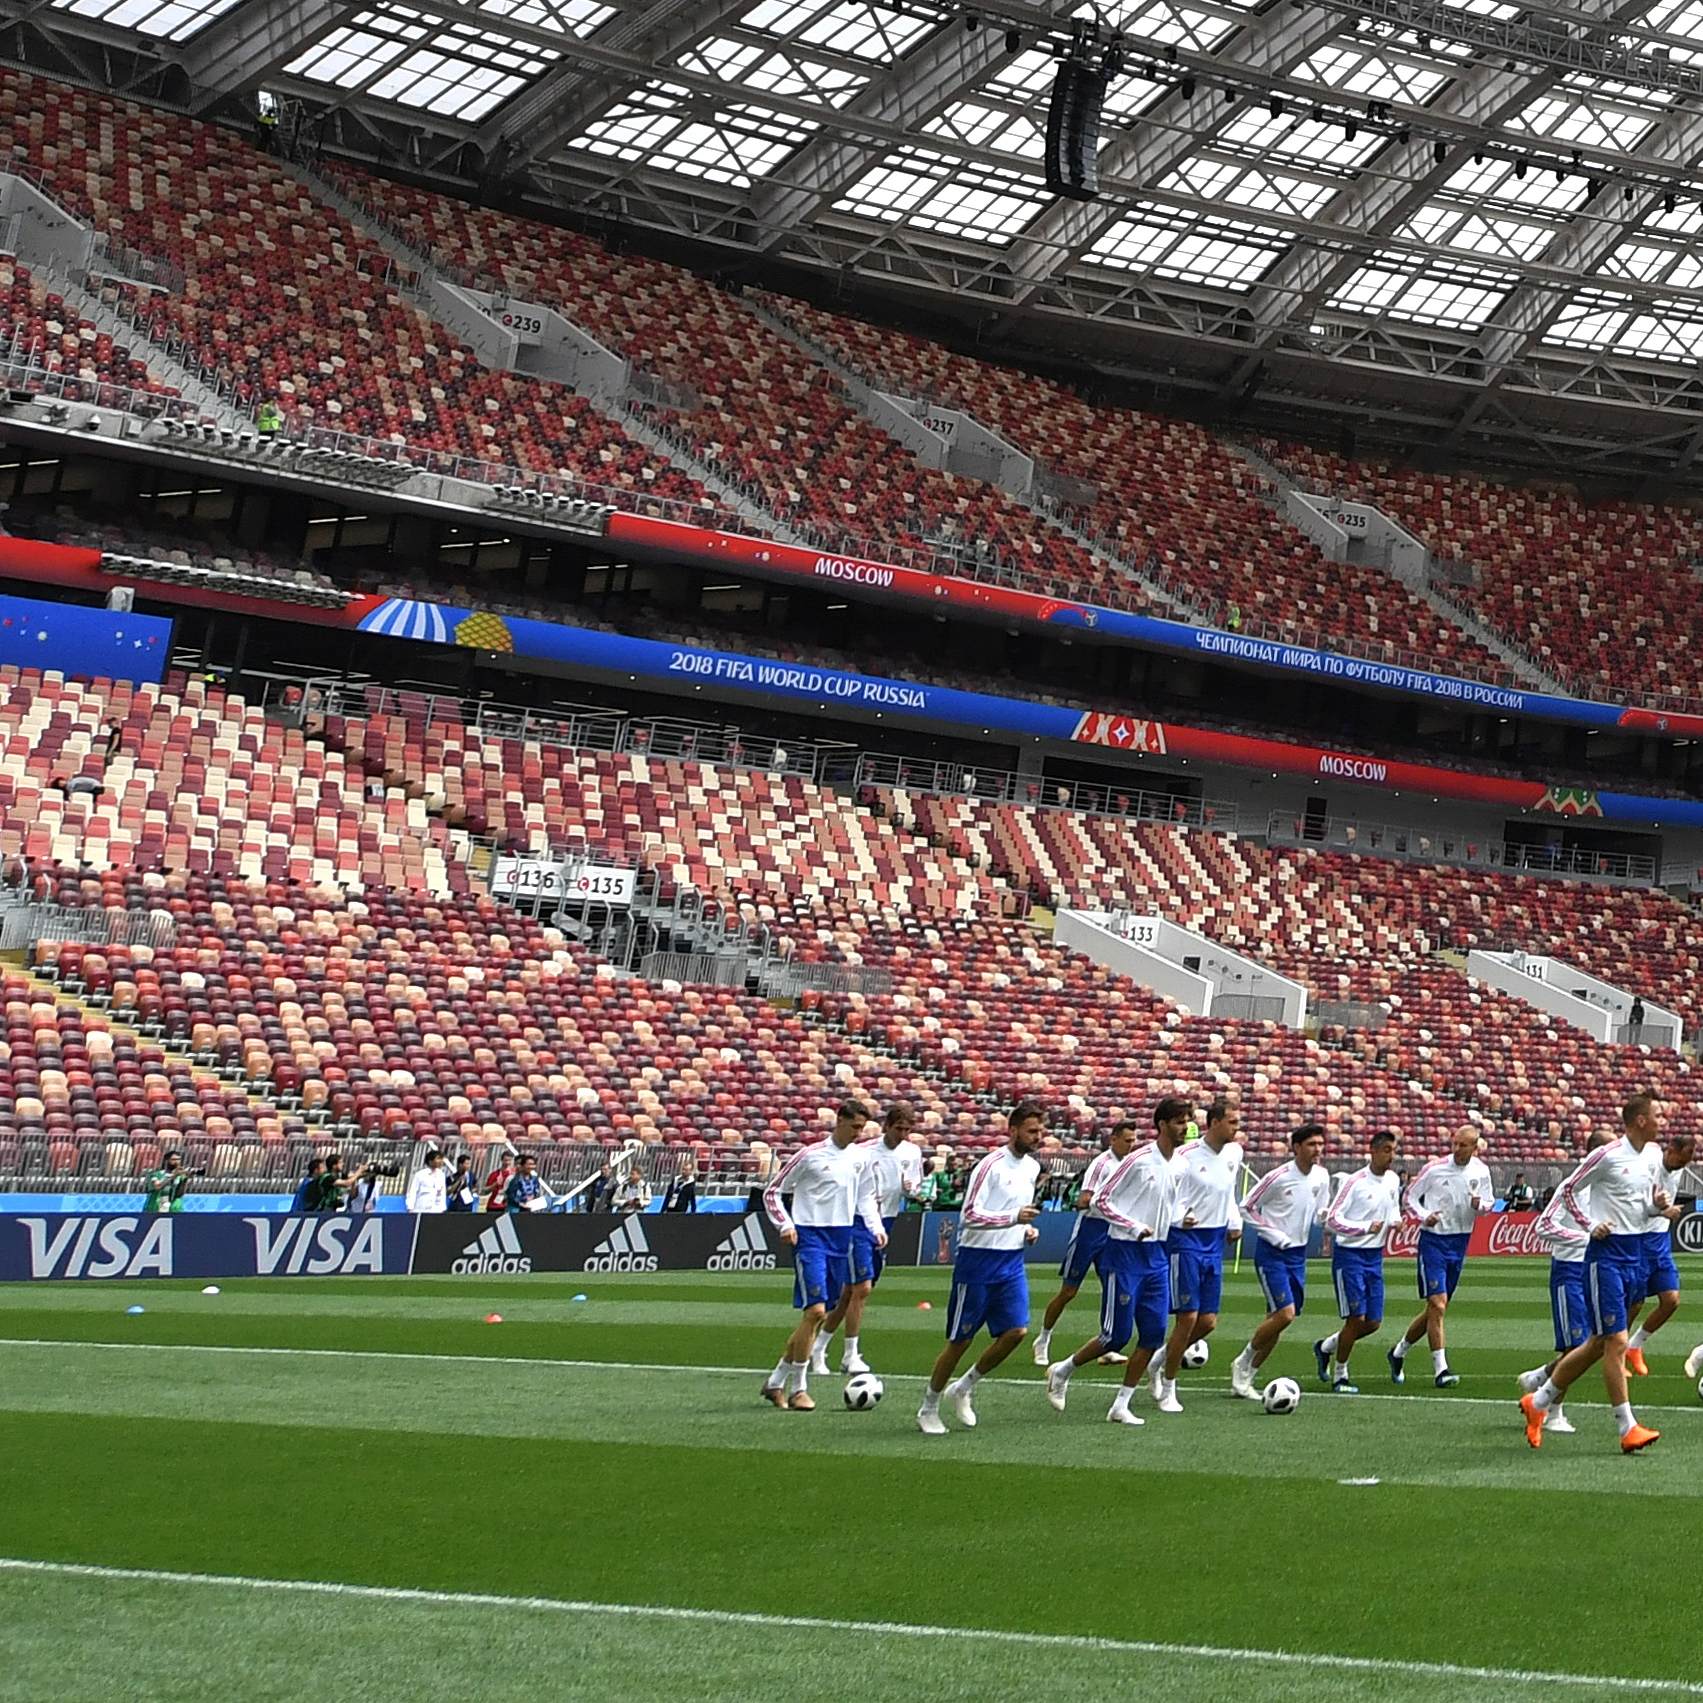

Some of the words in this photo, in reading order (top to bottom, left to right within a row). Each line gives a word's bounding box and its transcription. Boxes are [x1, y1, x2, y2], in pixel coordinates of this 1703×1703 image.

[513, 315, 541, 334] 239
[931, 418, 955, 435] 237
[1345, 514, 1366, 528] 235
[814, 557, 894, 587] MOSCOW
[669, 651, 713, 675] 2018
[715, 658, 754, 682] FIFA
[758, 664, 822, 692] WORLD
[824, 677, 862, 697] CUP
[863, 683, 927, 709] RUSSIA
[1196, 631, 1281, 663] ЧЕМПИОНАТ
[1282, 649, 1322, 671] МИРА
[1324, 657, 1343, 674] ПО
[1345, 661, 1406, 689] ФУТБОЛУ
[1407, 672, 1433, 692] FIFA
[1435, 679, 1462, 697] 2018
[1464, 684, 1473, 699] В
[1474, 687, 1523, 710] РОССИИ
[1319, 754, 1387, 782] MOSCOW
[521, 870, 555, 889] 136
[592, 877, 624, 896] 135
[1129, 926, 1153, 942] 133
[1526, 964, 1543, 980] 131
[16, 1217, 174, 1278] VISA
[242, 1216, 384, 1274] VISA
[451, 1253, 532, 1275] adidas
[583, 1252, 659, 1272] adidas
[706, 1250, 776, 1271] adidas
